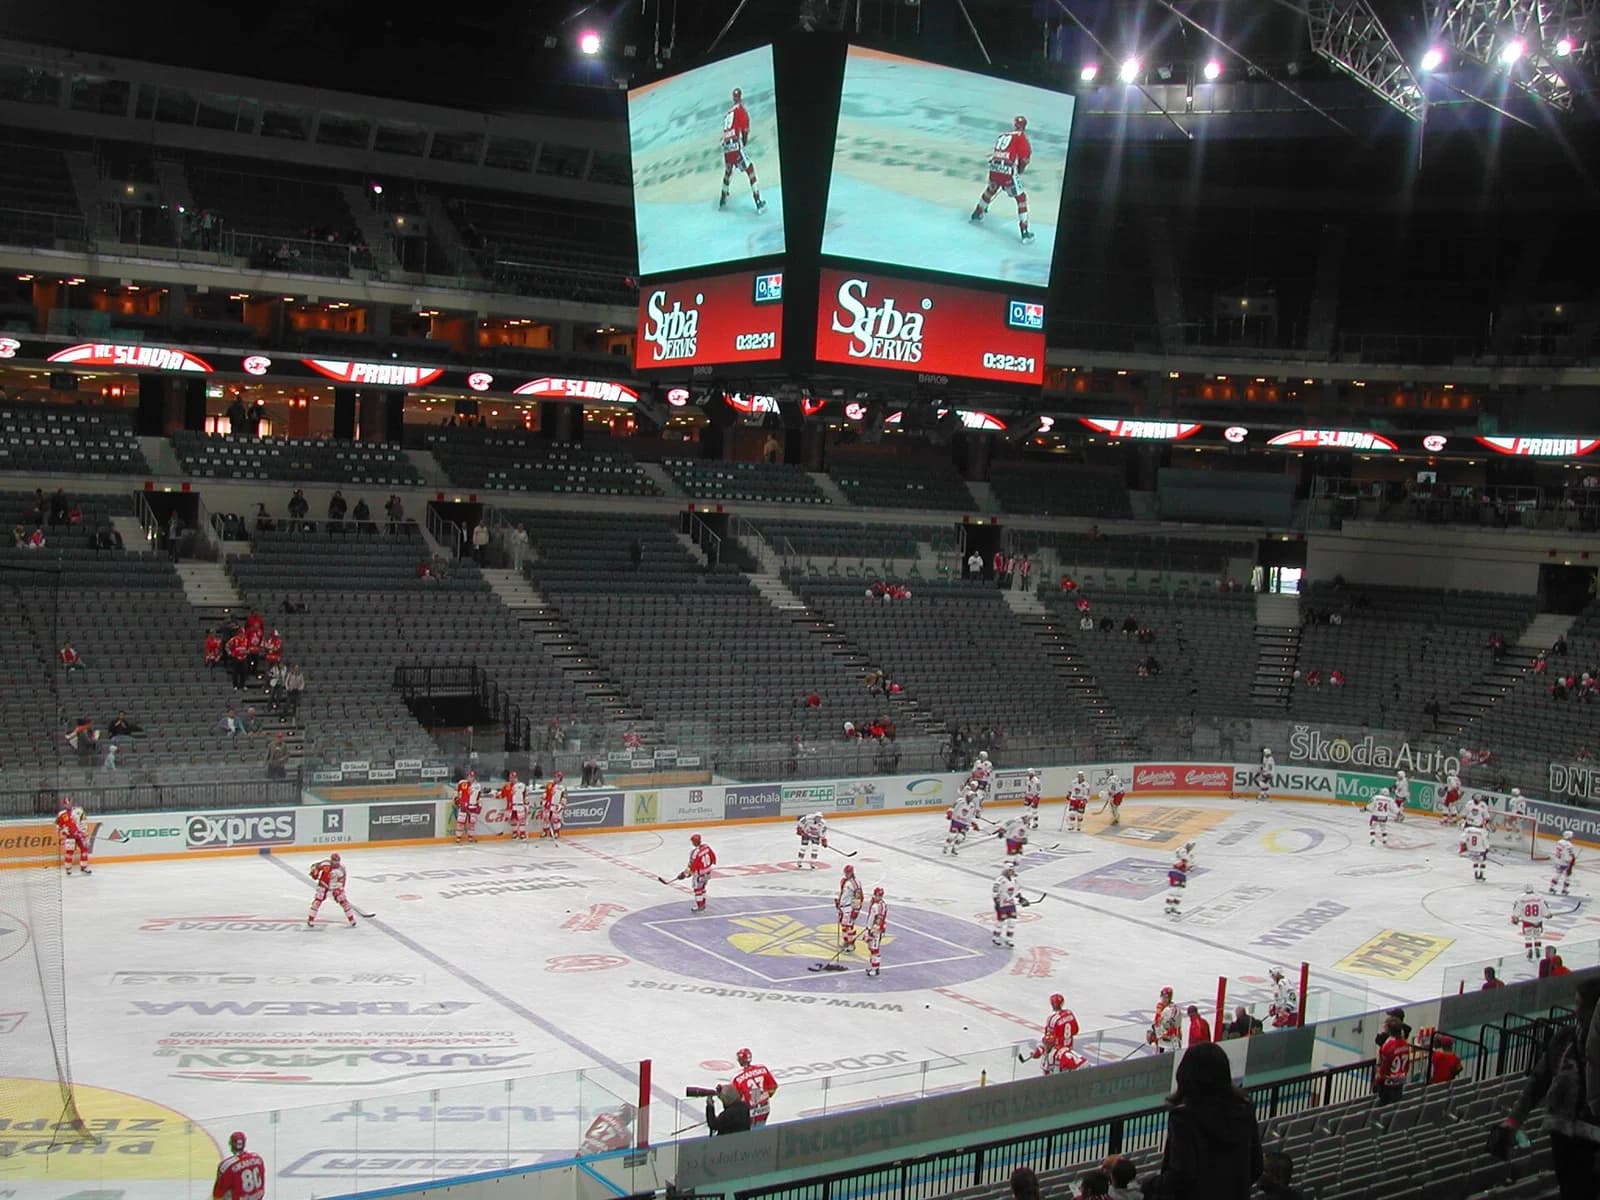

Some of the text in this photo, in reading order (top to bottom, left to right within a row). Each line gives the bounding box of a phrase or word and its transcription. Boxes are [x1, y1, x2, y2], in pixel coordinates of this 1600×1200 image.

[832, 279, 924, 342] Srba
[736, 331, 775, 351] 0:32:31
[114, 345, 185, 370] SLAVIA
[983, 352, 1035, 373] 0:32:31
[350, 362, 419, 386] PRAHA
[739, 792, 781, 805] machala
[1378, 802, 1388, 812] 24
[372, 814, 430, 824] JESPEN
[564, 808, 605, 818] SHERLOG
[119, 828, 181, 838] VEIDEC
[187, 816, 293, 847] expres
[625, 980, 904, 1014] www.exekutor.net
[134, 1001, 410, 1016] BREMA
